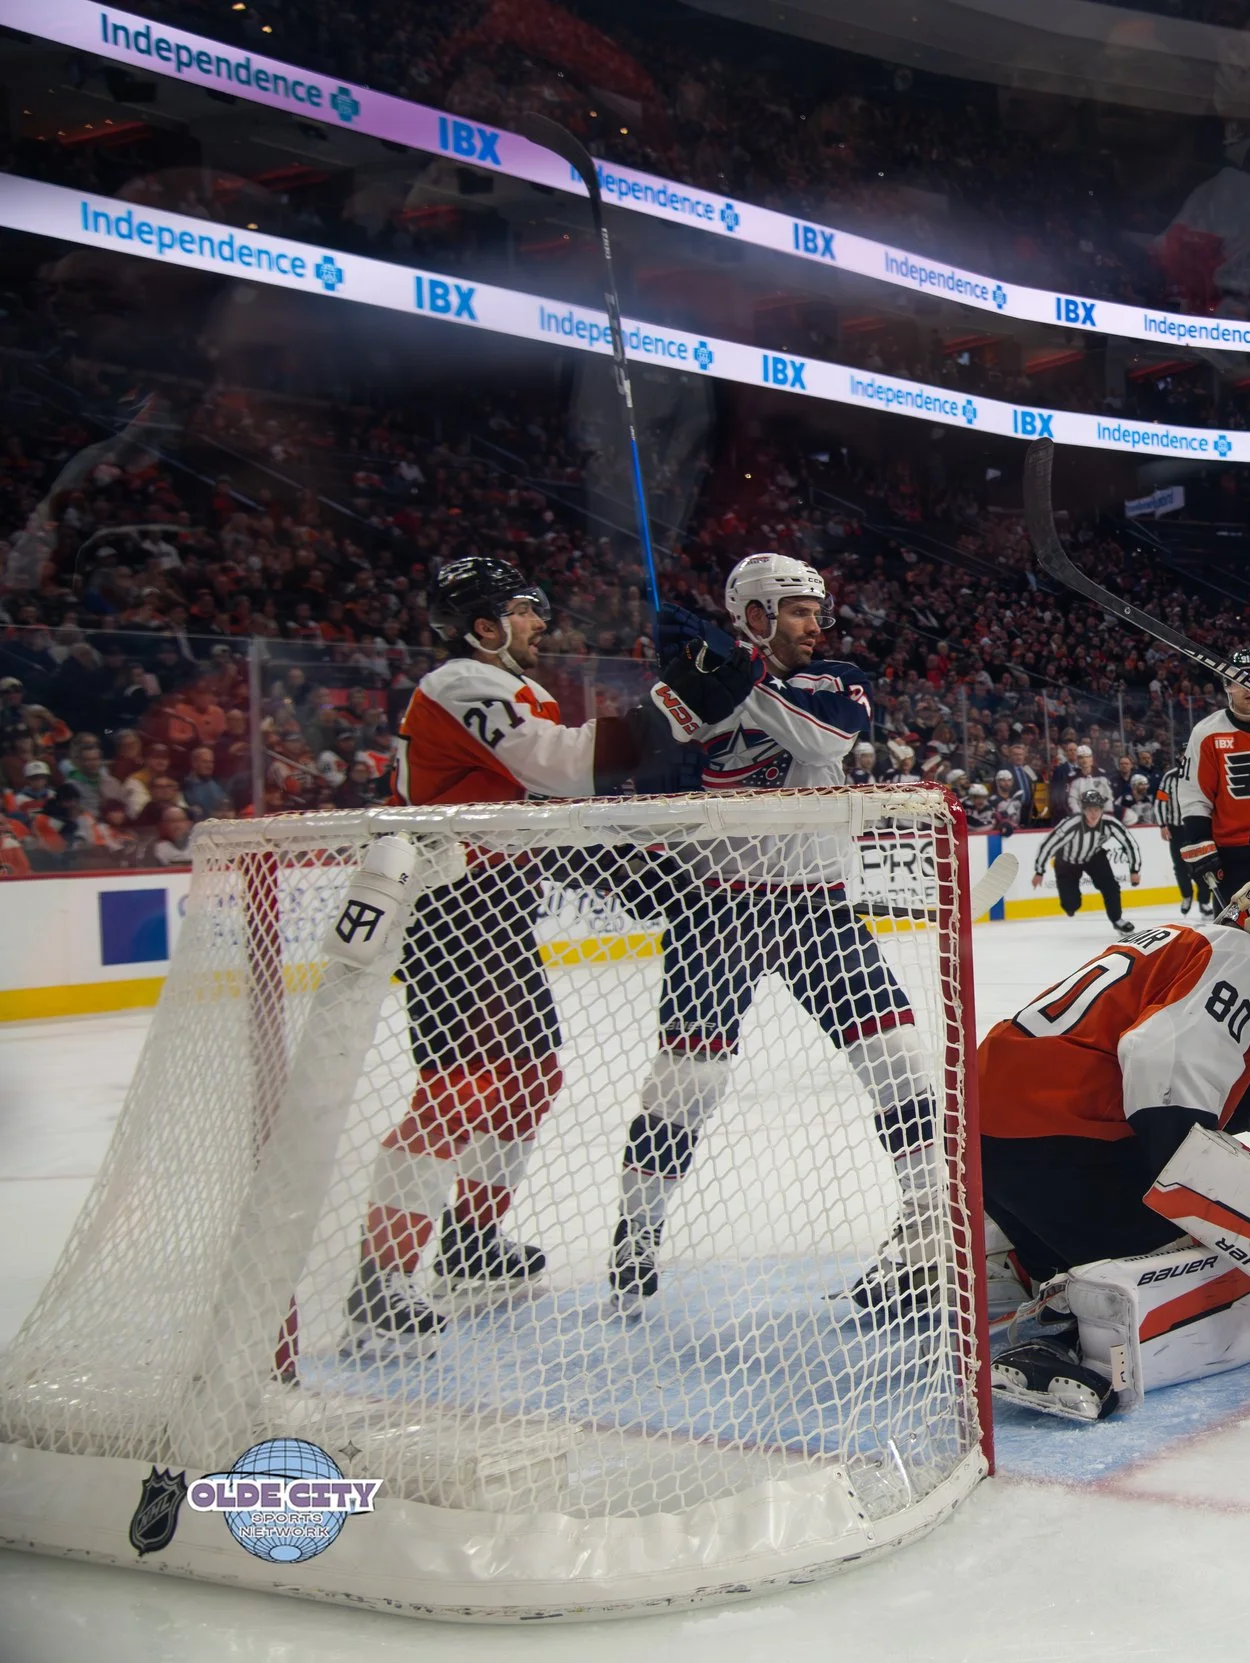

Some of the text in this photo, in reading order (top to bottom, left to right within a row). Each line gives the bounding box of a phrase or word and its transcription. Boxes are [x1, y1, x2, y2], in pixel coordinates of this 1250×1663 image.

[100, 12, 323, 108] Independence
[438, 116, 501, 166] IBX
[81, 201, 306, 278] Independence
[793, 222, 836, 261] IBX
[884, 252, 989, 301] Independence
[414, 276, 478, 322] IBX
[1056, 297, 1097, 327] IBX
[763, 354, 806, 391] IBX
[850, 374, 958, 417] Independence
[1013, 410, 1054, 439] IBX
[1097, 422, 1208, 451] Independence
[463, 700, 525, 750] 27
[1214, 737, 1234, 749] IBX
[1137, 1255, 1219, 1286] BAUER
